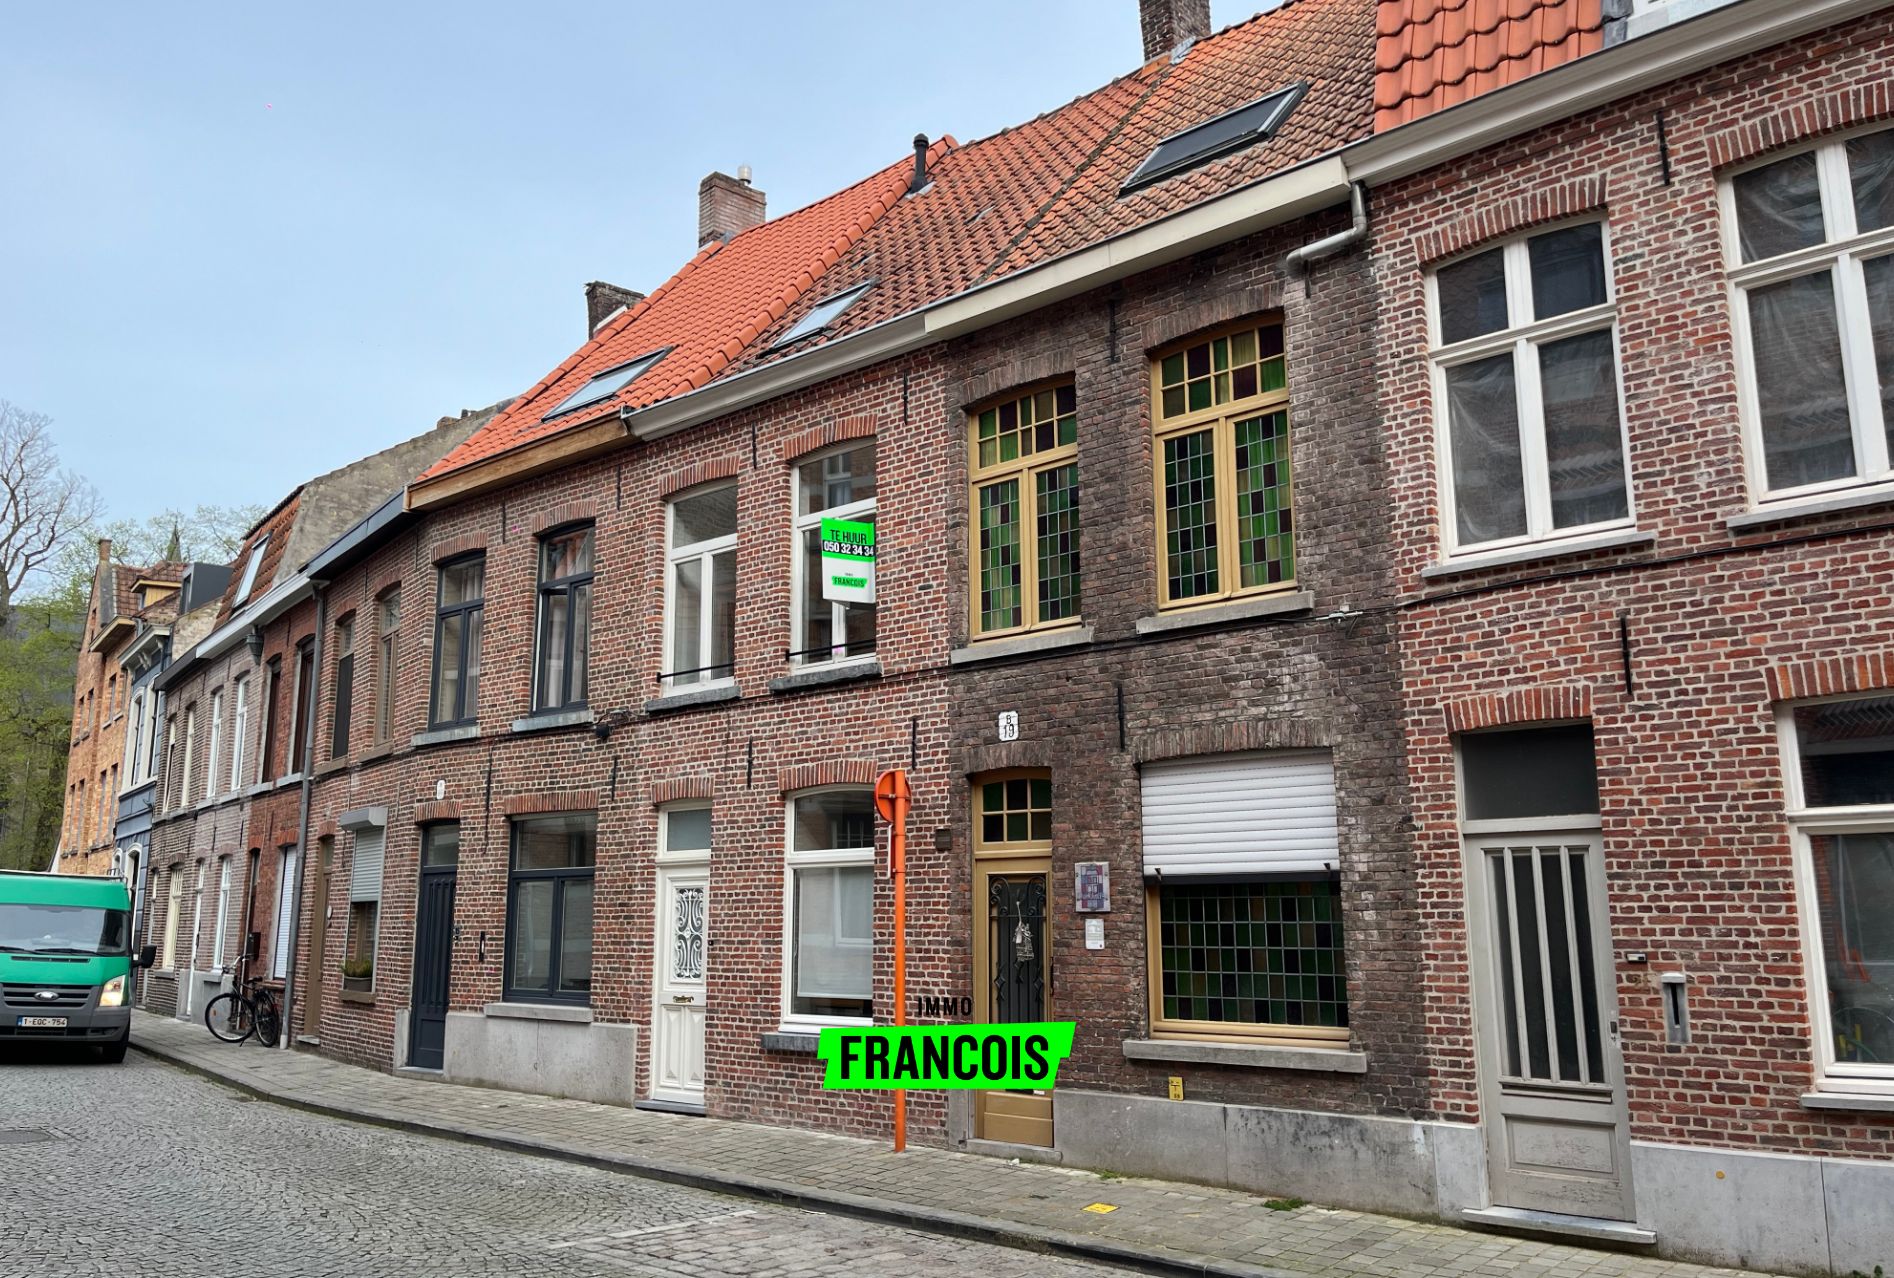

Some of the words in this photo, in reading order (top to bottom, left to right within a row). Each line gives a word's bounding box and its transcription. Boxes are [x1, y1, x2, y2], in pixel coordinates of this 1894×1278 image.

[830, 529, 840, 541] TE
[842, 531, 867, 544] HUUR
[823, 540, 840, 552] 050
[841, 542, 851, 554] 32
[852, 544, 863, 556] 34
[864, 546, 874, 556] 34
[834, 577, 865, 588] FRANCOIS
[1004, 723, 1015, 738] 19
